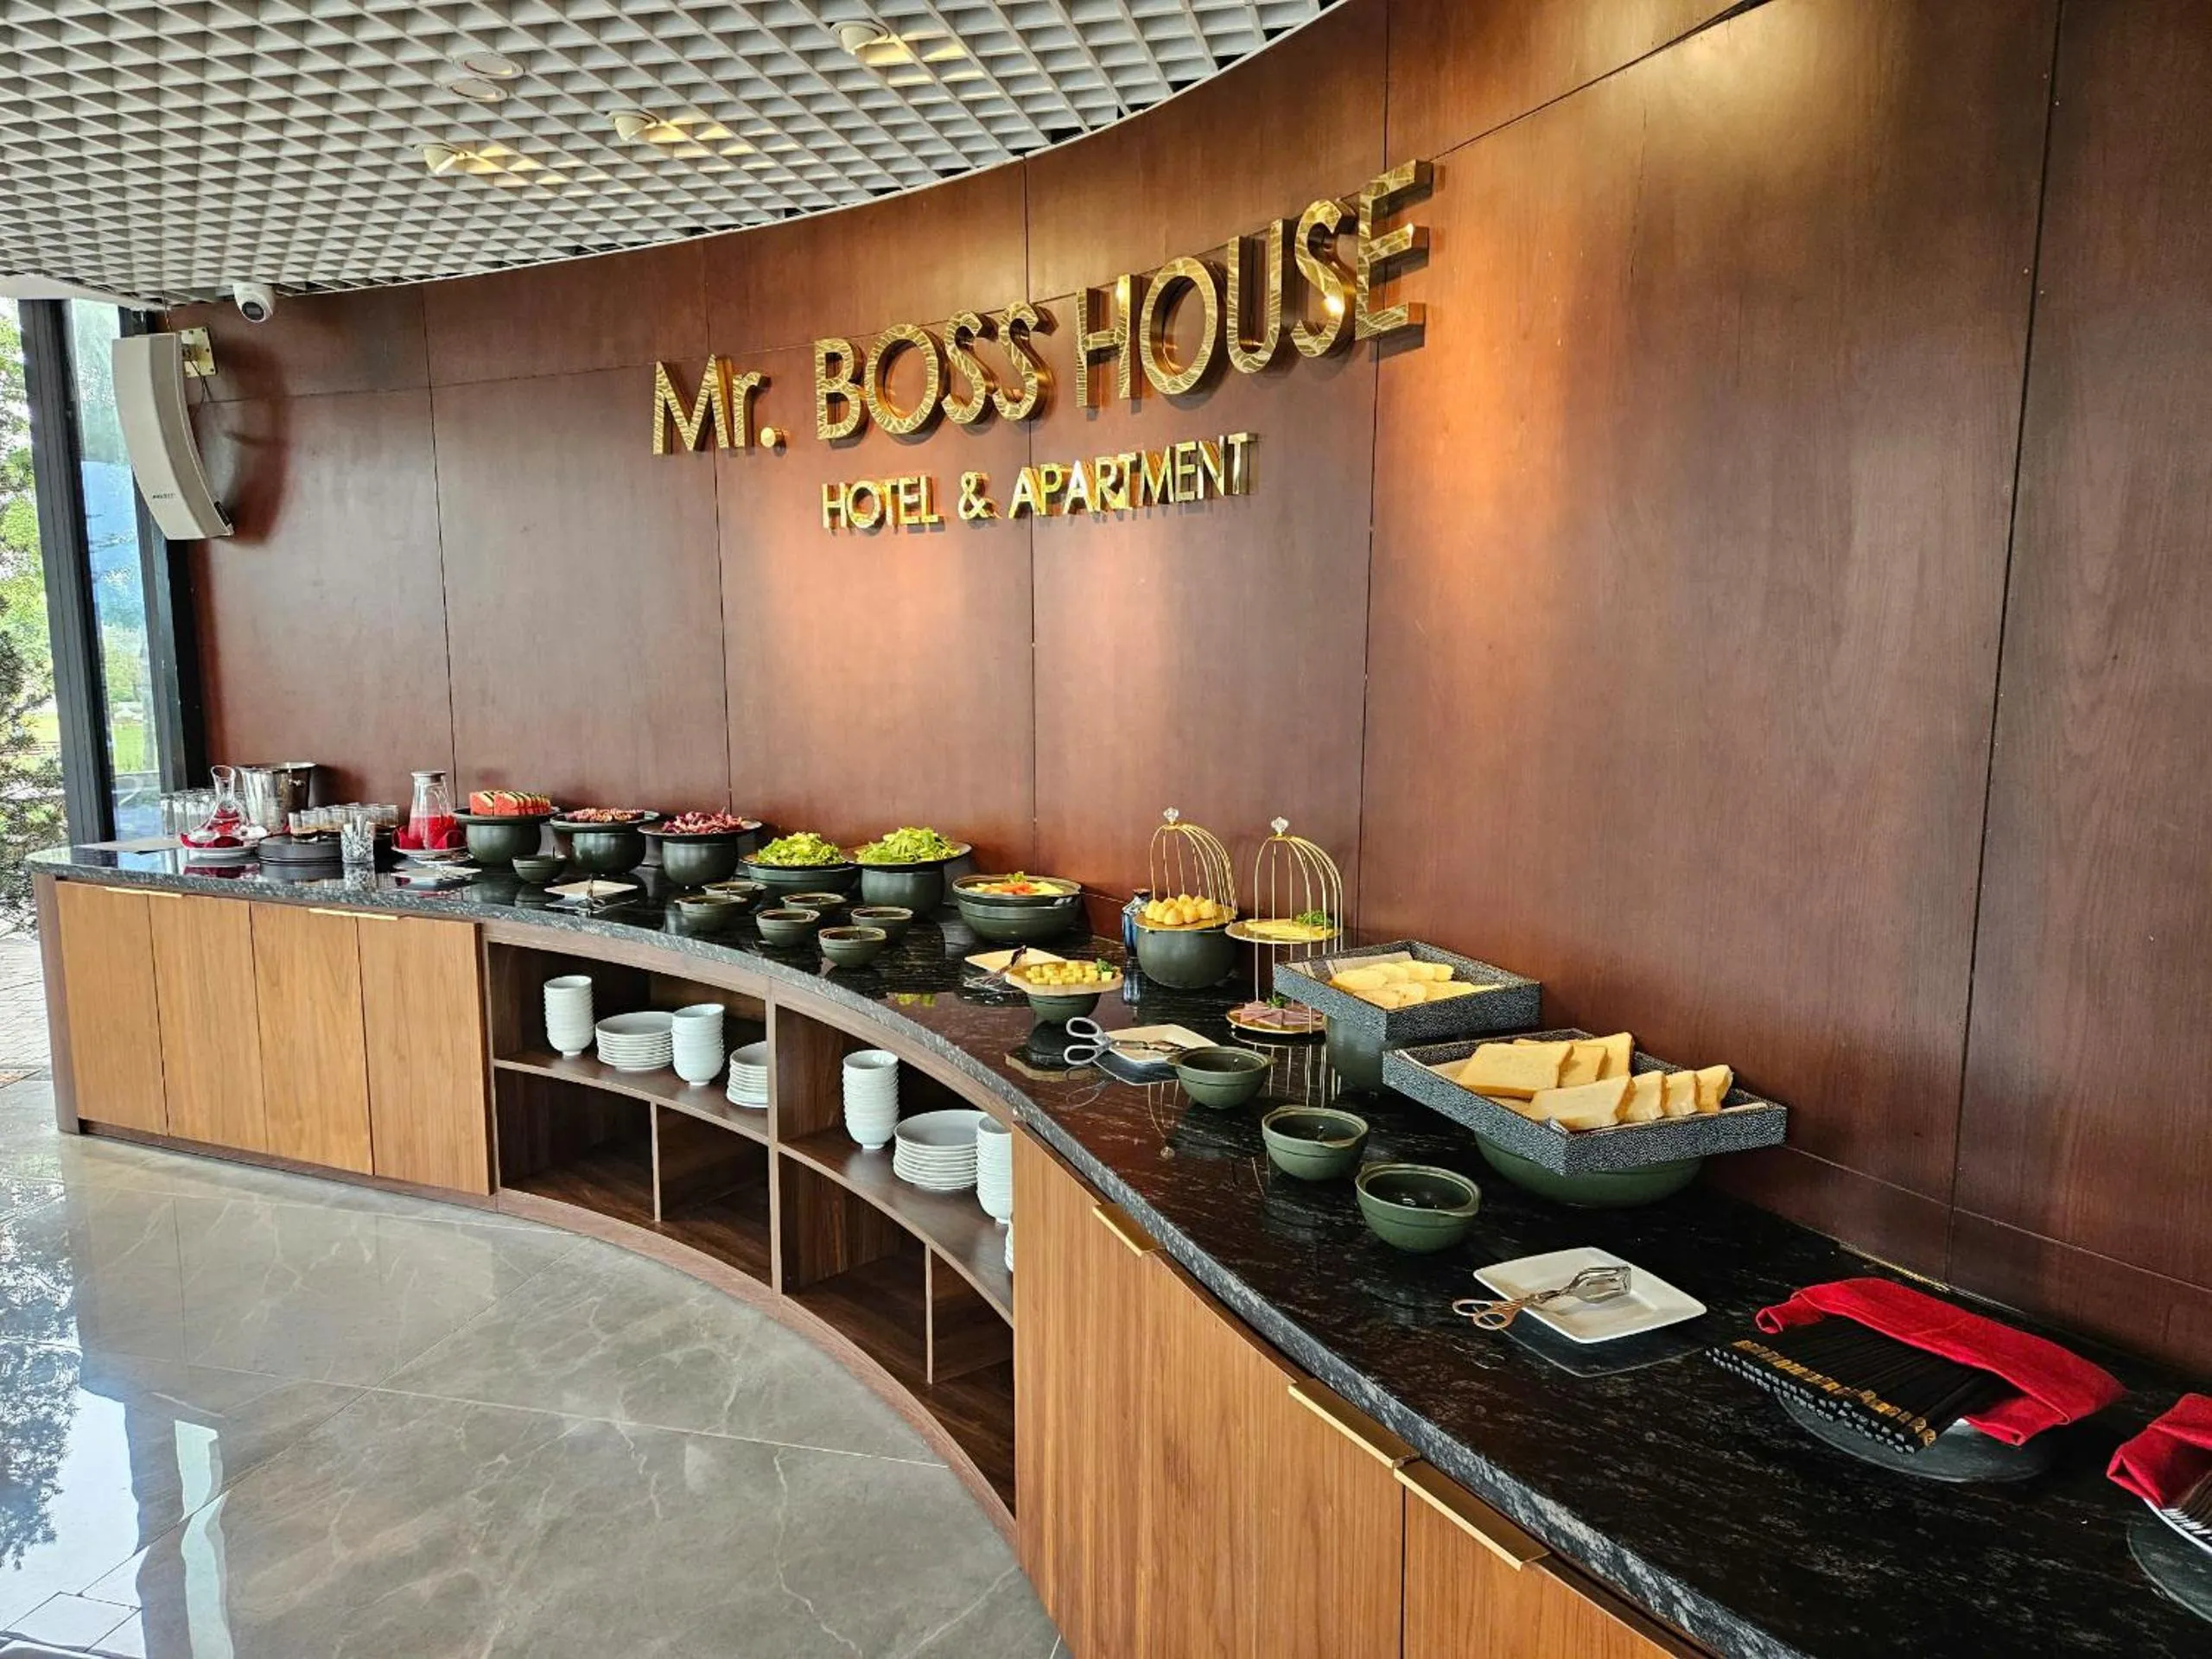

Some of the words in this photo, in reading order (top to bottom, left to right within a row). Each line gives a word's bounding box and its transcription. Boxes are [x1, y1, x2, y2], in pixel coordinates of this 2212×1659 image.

[652, 353, 783, 455] Mr.
[814, 301, 1051, 440] BOSS
[1076, 159, 1432, 408] HOUSE
[821, 474, 940, 531] HOTEL
[957, 471, 997, 521] &
[1007, 432, 1255, 519] APARTMENT
